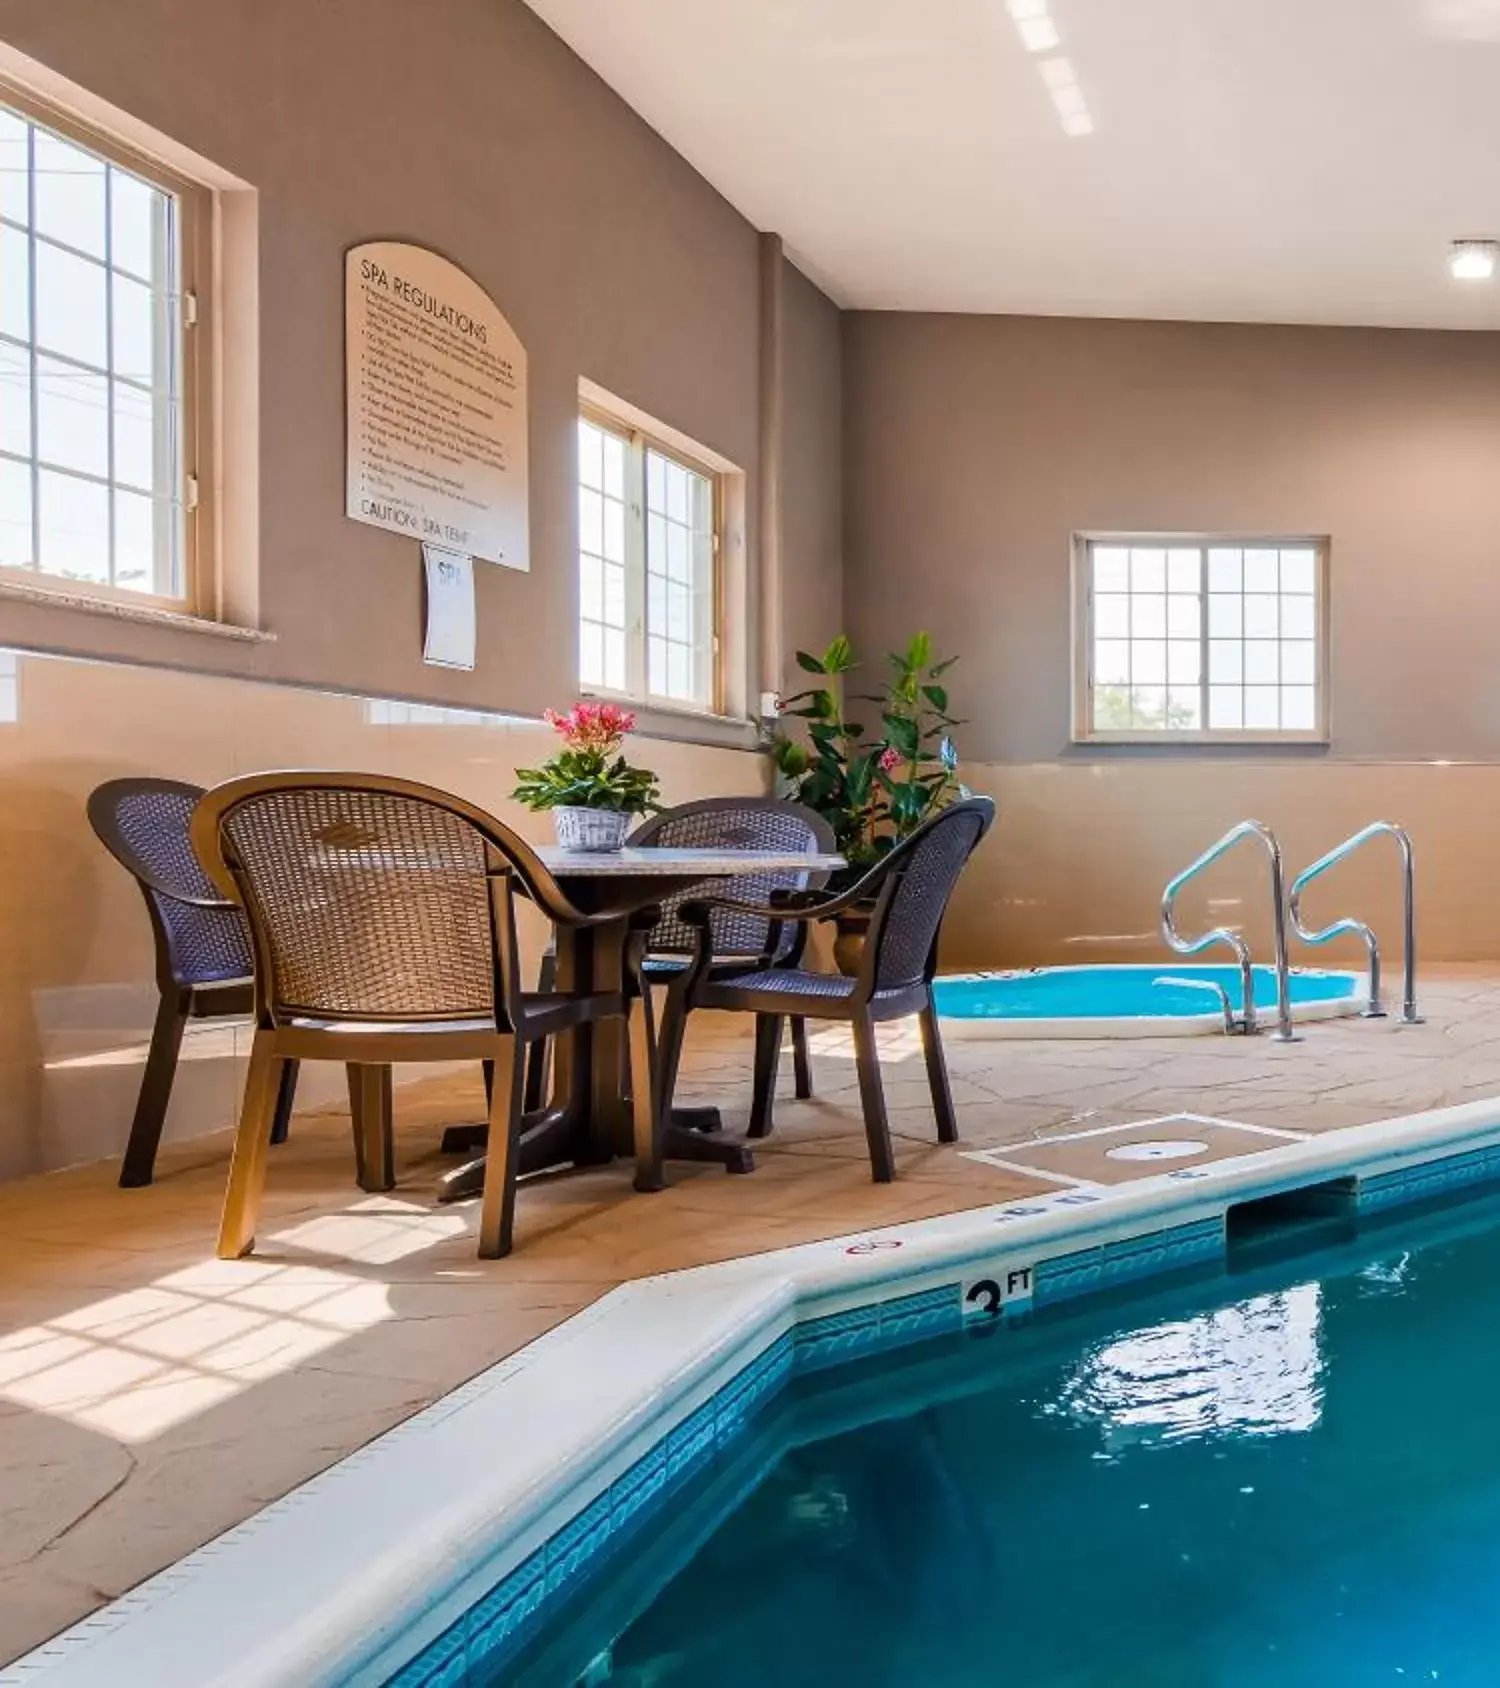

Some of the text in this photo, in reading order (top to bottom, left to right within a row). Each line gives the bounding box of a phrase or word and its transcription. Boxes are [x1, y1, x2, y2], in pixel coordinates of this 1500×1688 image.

[361, 259, 487, 344] SPA REGULATIONS
[1007, 1267, 1032, 1294] FT
